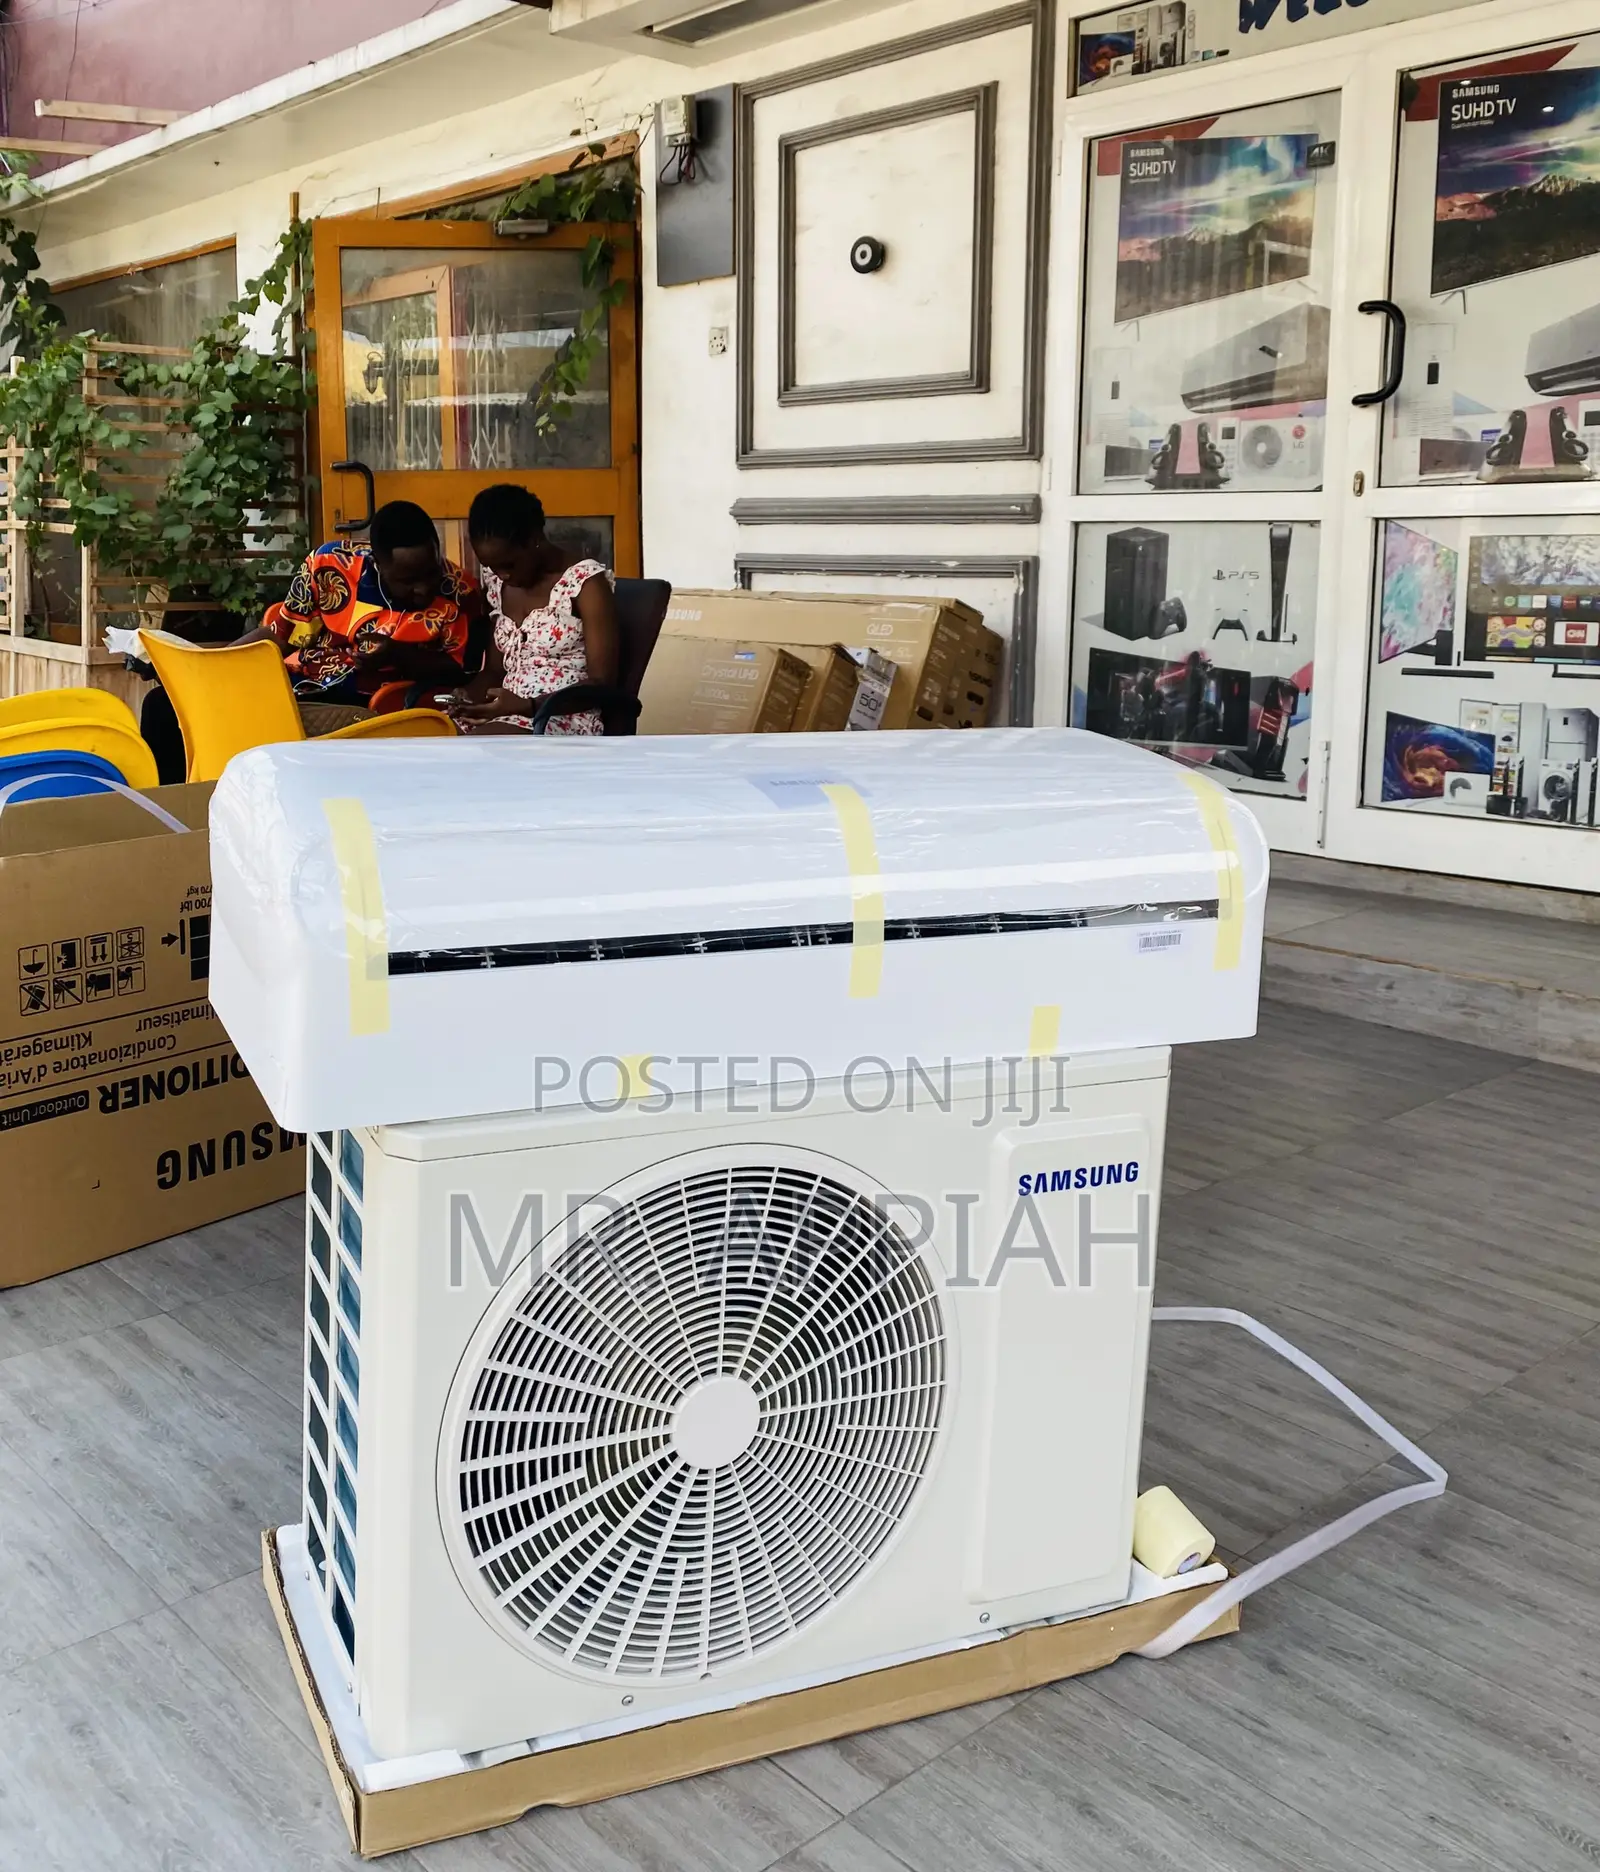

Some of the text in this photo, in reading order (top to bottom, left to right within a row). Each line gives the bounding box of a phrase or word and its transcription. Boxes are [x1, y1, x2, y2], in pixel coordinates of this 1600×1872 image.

[1452, 84, 1500, 98] SAMSUNG
[1228, 570, 1260, 580] PS5
[136, 1004, 217, 1033] limatiseur
[53, 1034, 176, 1080] Condizionatore
[97, 1053, 249, 1114] DITIONER
[1, 1094, 87, 1126] Outdoor Unit
[156, 1122, 306, 1190] MSUNG
[1018, 1161, 1139, 1196] SAMSUNG
